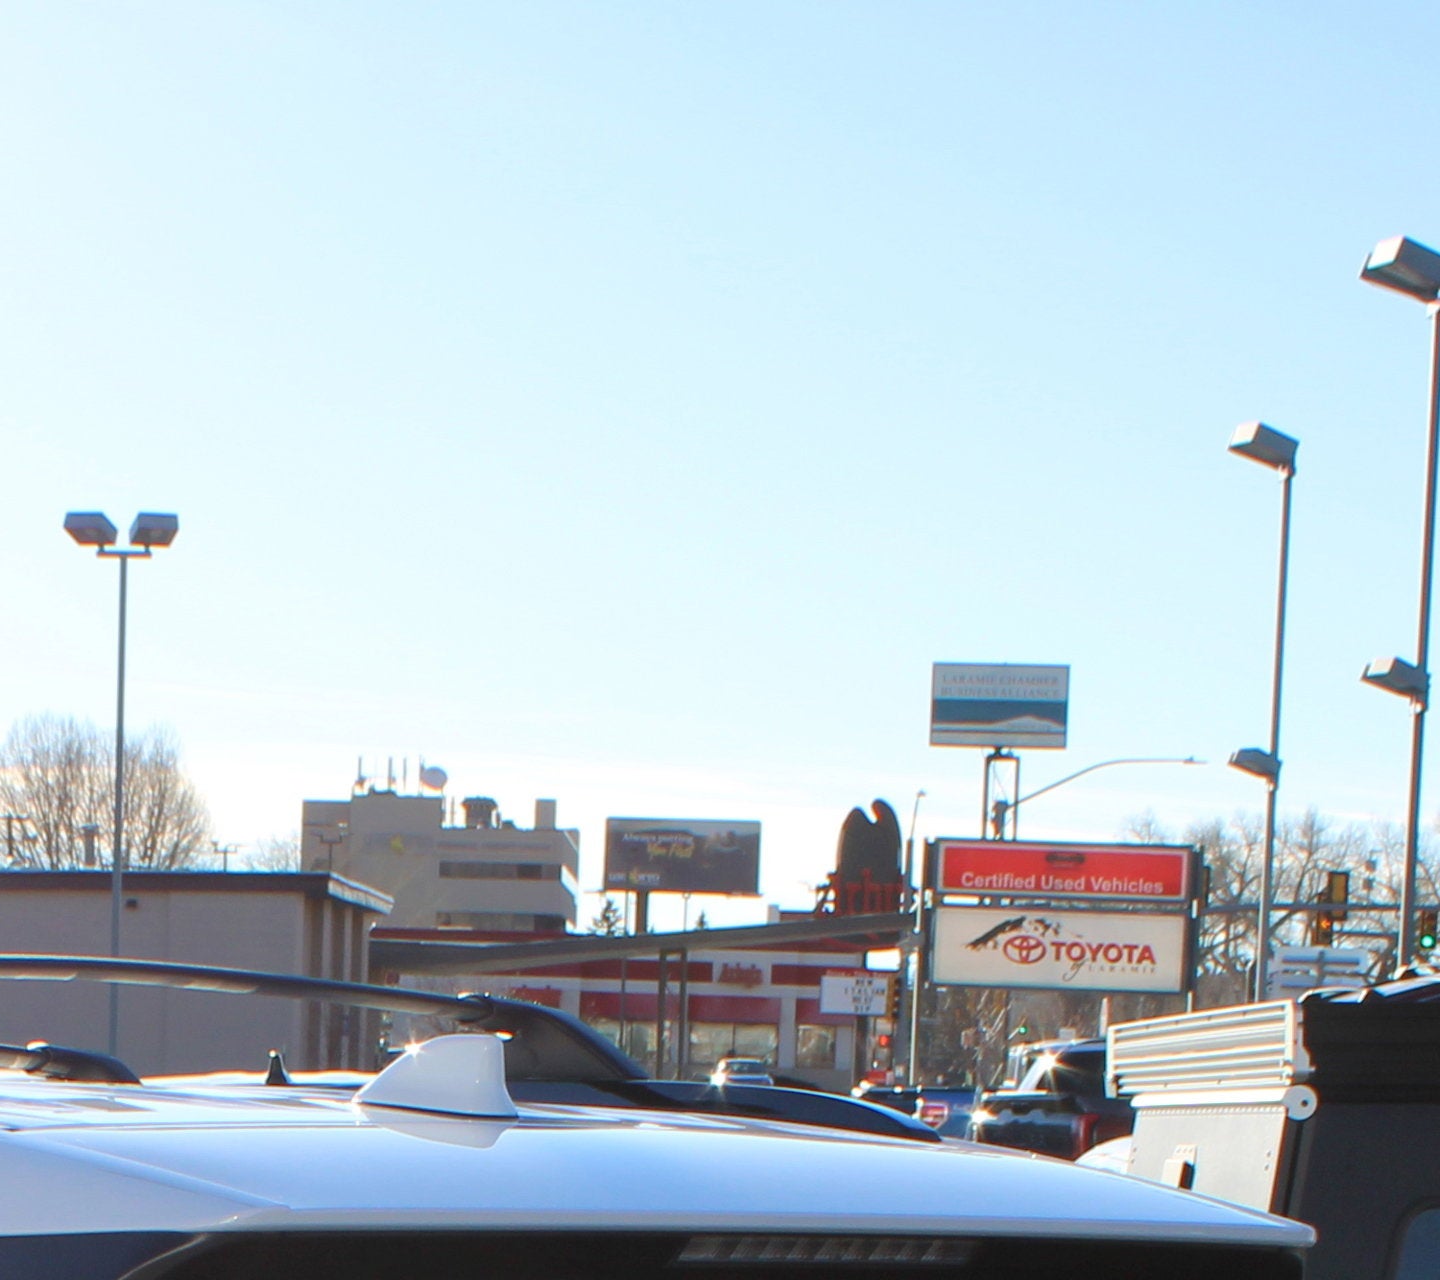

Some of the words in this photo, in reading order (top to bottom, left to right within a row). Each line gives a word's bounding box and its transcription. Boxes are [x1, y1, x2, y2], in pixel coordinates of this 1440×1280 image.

[942, 675, 995, 685] LARAMIE
[999, 676, 1058, 686] CHAMBER
[940, 687, 996, 697] BUSINESS
[1000, 688, 1058, 698] ALLIANCE
[961, 872, 1035, 890] Certified
[1041, 874, 1086, 891] Used
[1089, 876, 1164, 894] Vehicles
[1050, 941, 1157, 965] TOYOTA
[1088, 965, 1158, 974] LARAMIE
